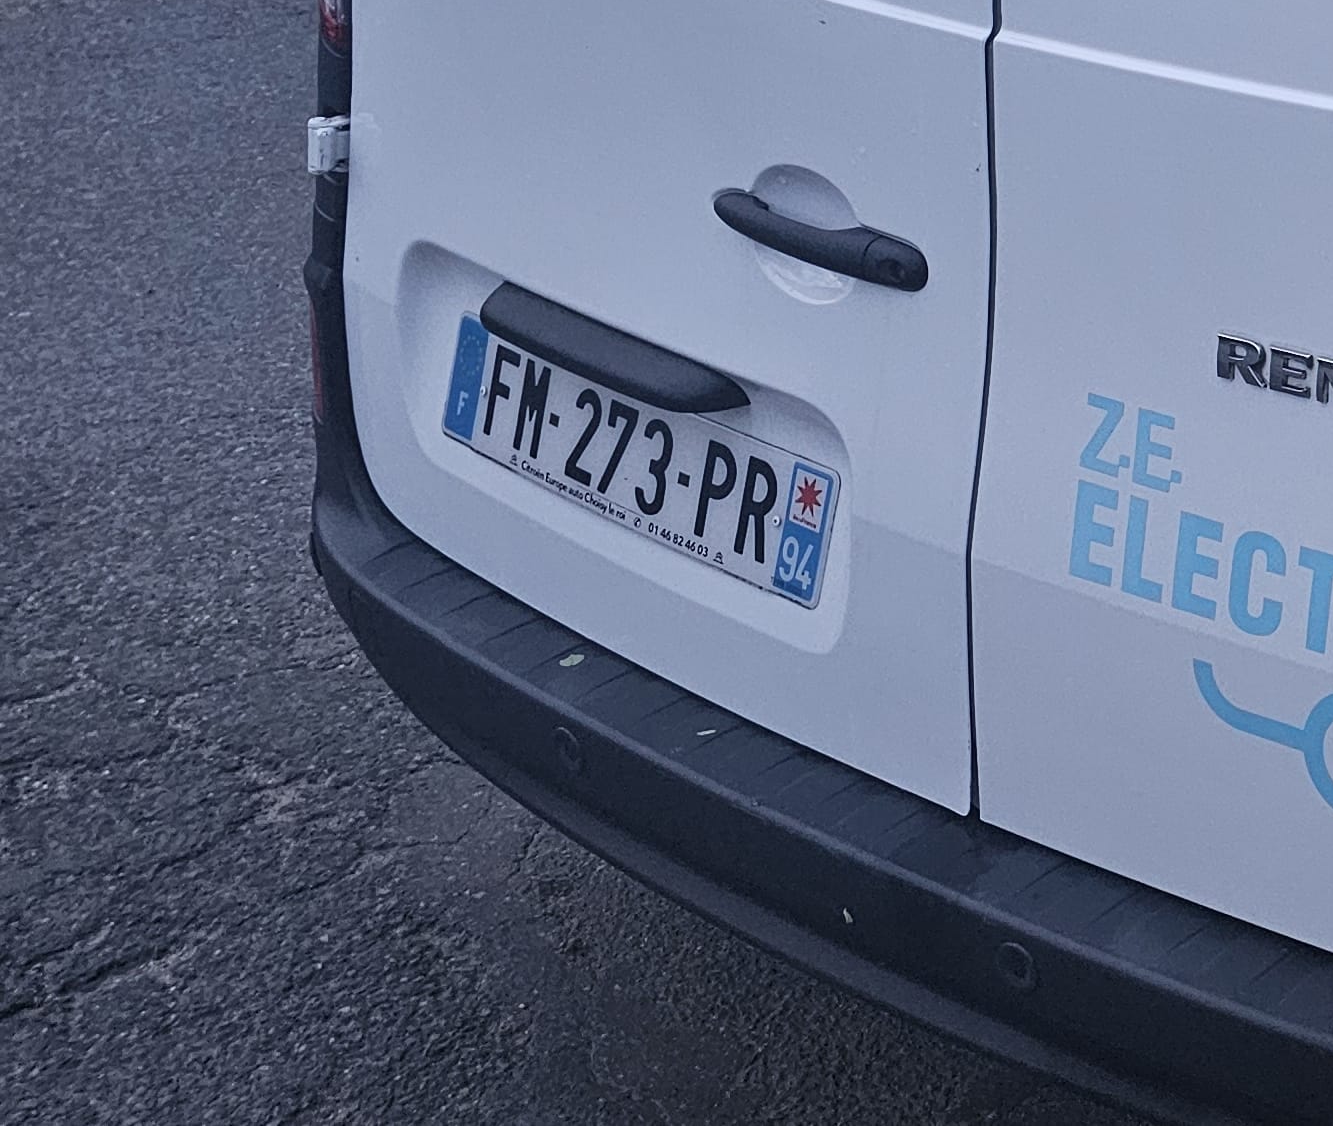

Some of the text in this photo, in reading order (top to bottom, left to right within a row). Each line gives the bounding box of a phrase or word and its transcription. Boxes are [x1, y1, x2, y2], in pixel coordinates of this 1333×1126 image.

[455, 390, 468, 416] F
[483, 344, 778, 564] FM-273-PR
[1079, 392, 1182, 493] Z.E.
[648, 522, 659, 536] 01
[660, 528, 671, 541] 46
[672, 533, 684, 547] 82
[684, 539, 696, 552] 46
[697, 544, 709, 558] 03
[779, 536, 814, 591] 94
